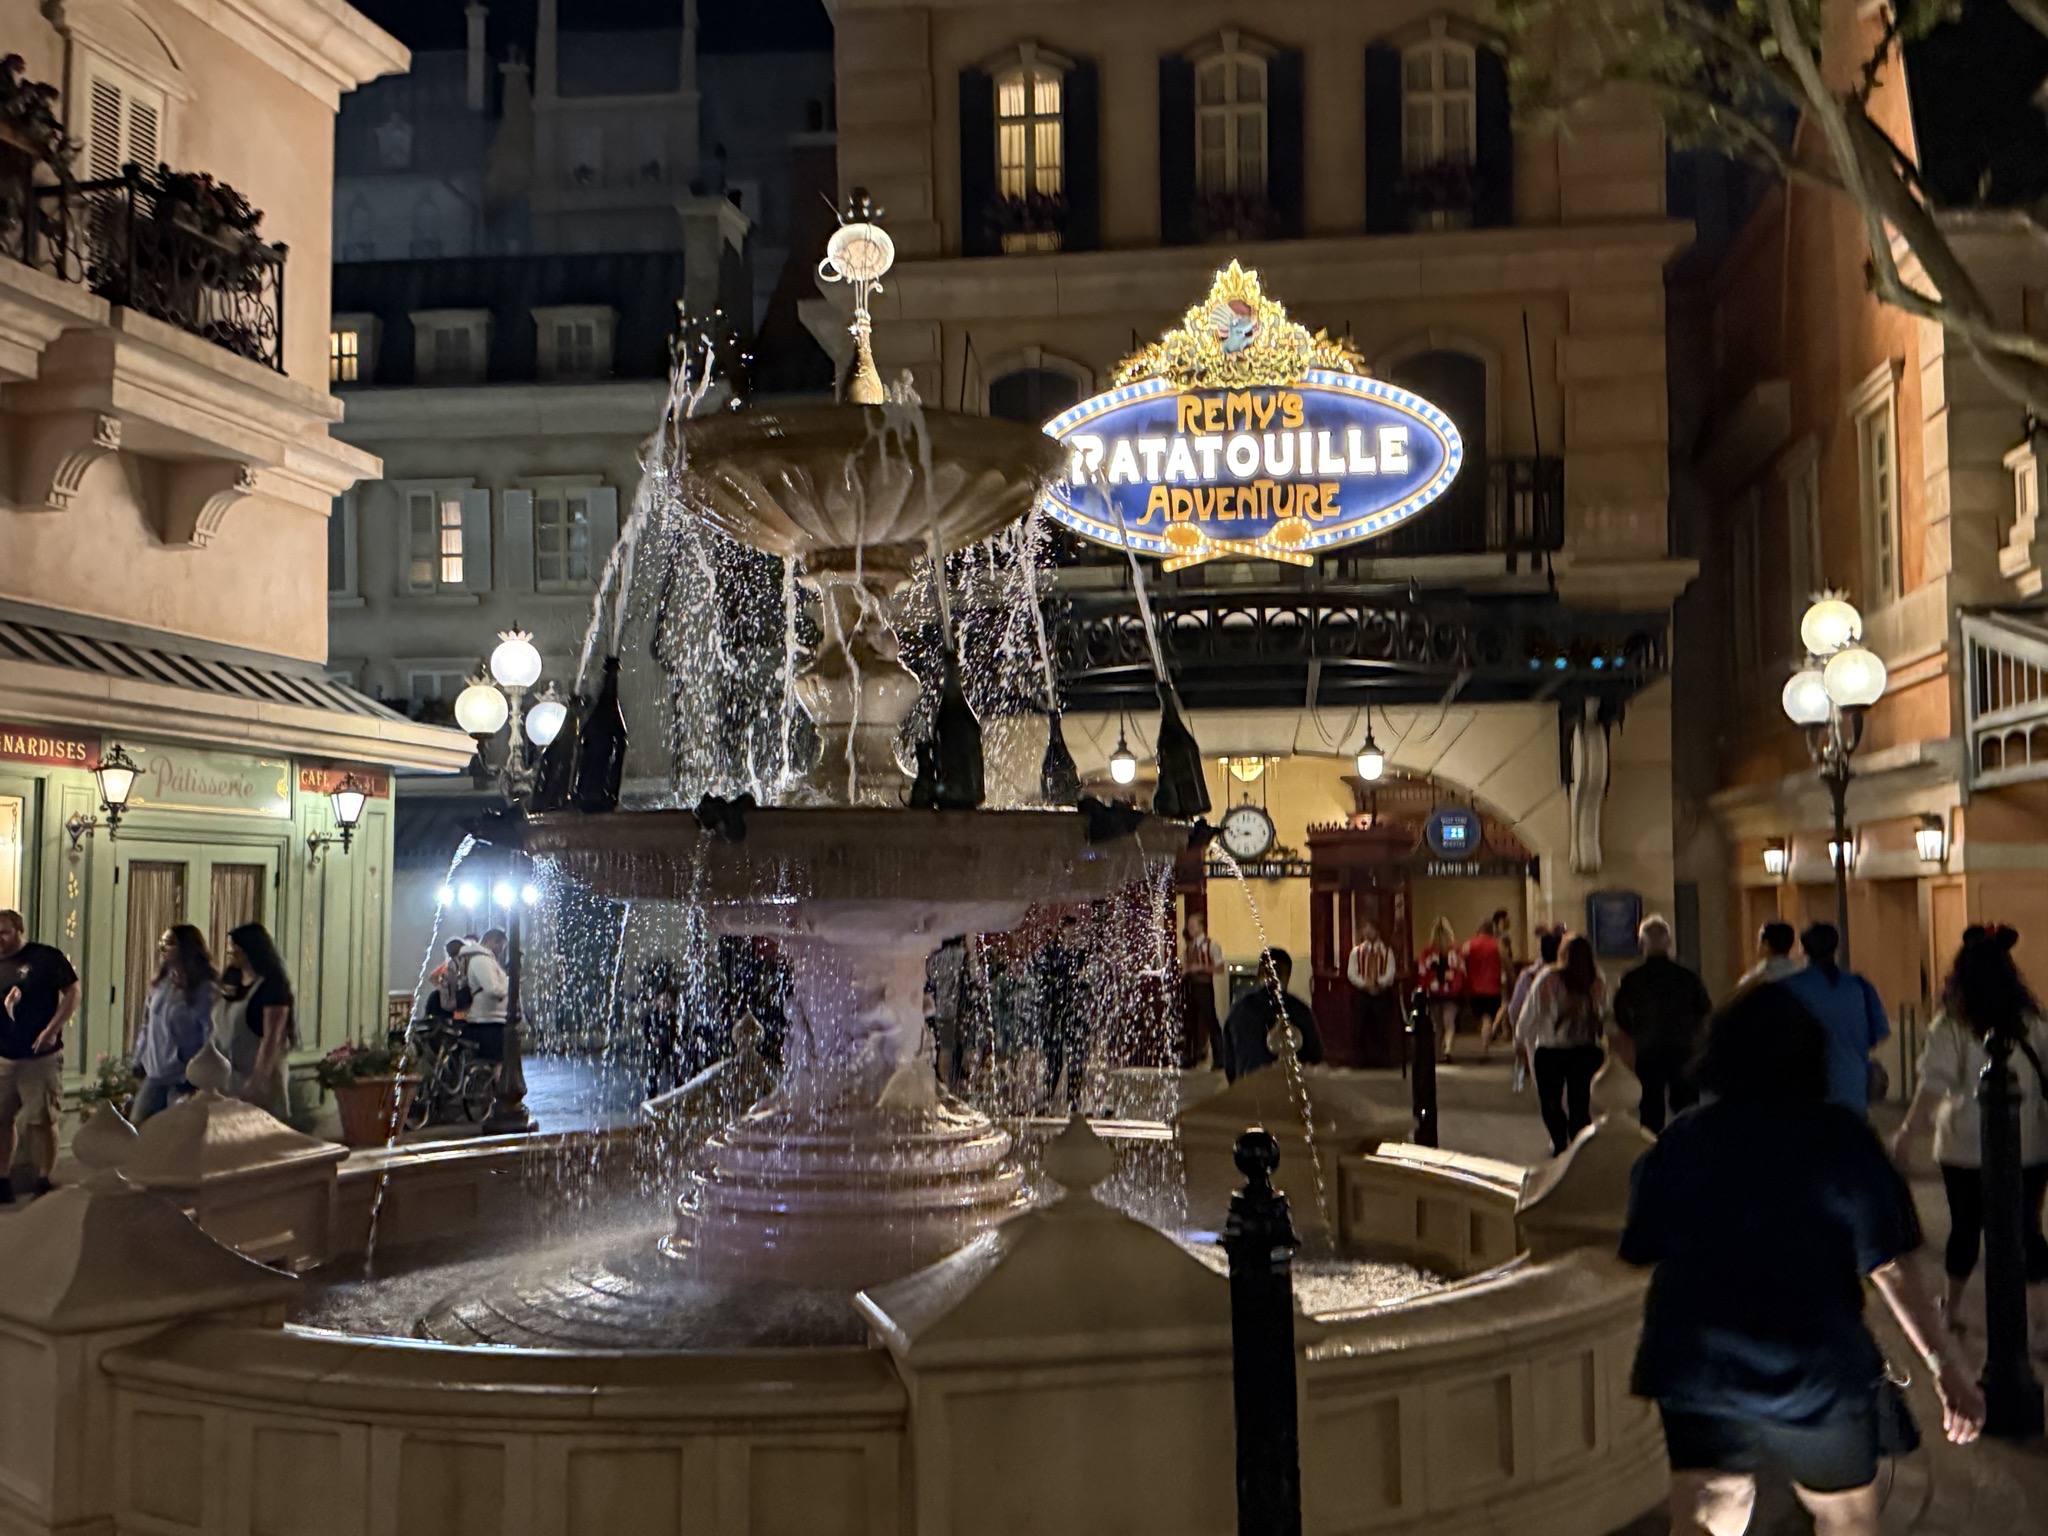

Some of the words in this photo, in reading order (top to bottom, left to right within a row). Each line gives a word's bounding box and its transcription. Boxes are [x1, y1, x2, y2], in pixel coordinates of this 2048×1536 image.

[1177, 390, 1304, 437] REMY'S
[1070, 426, 1410, 485] RATATOUILLE
[1136, 478, 1340, 526] ADVENTURE
[0, 734, 87, 761] NARDISES
[149, 755, 254, 798] Pâtisserie
[1450, 827, 1465, 838] 25
